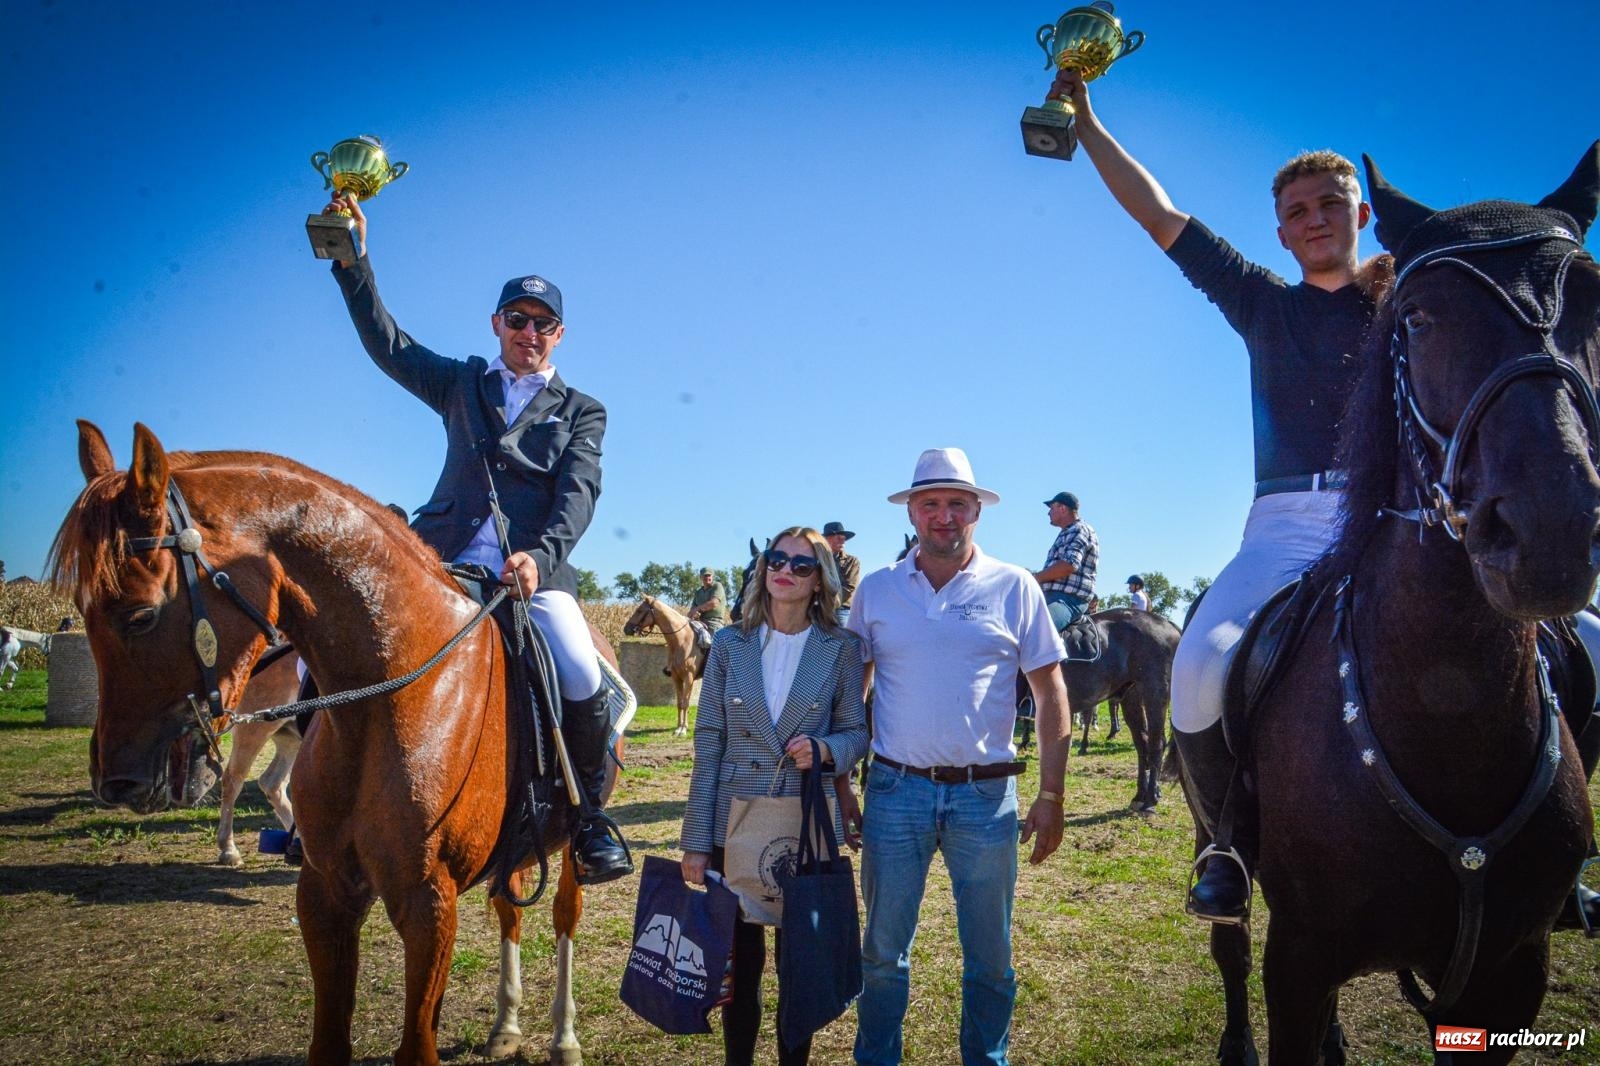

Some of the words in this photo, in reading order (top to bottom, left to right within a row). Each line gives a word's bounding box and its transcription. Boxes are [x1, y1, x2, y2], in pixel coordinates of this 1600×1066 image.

[630, 950, 662, 971] powiat
[628, 961, 654, 978] zielona
[676, 985, 705, 1000] kultur
